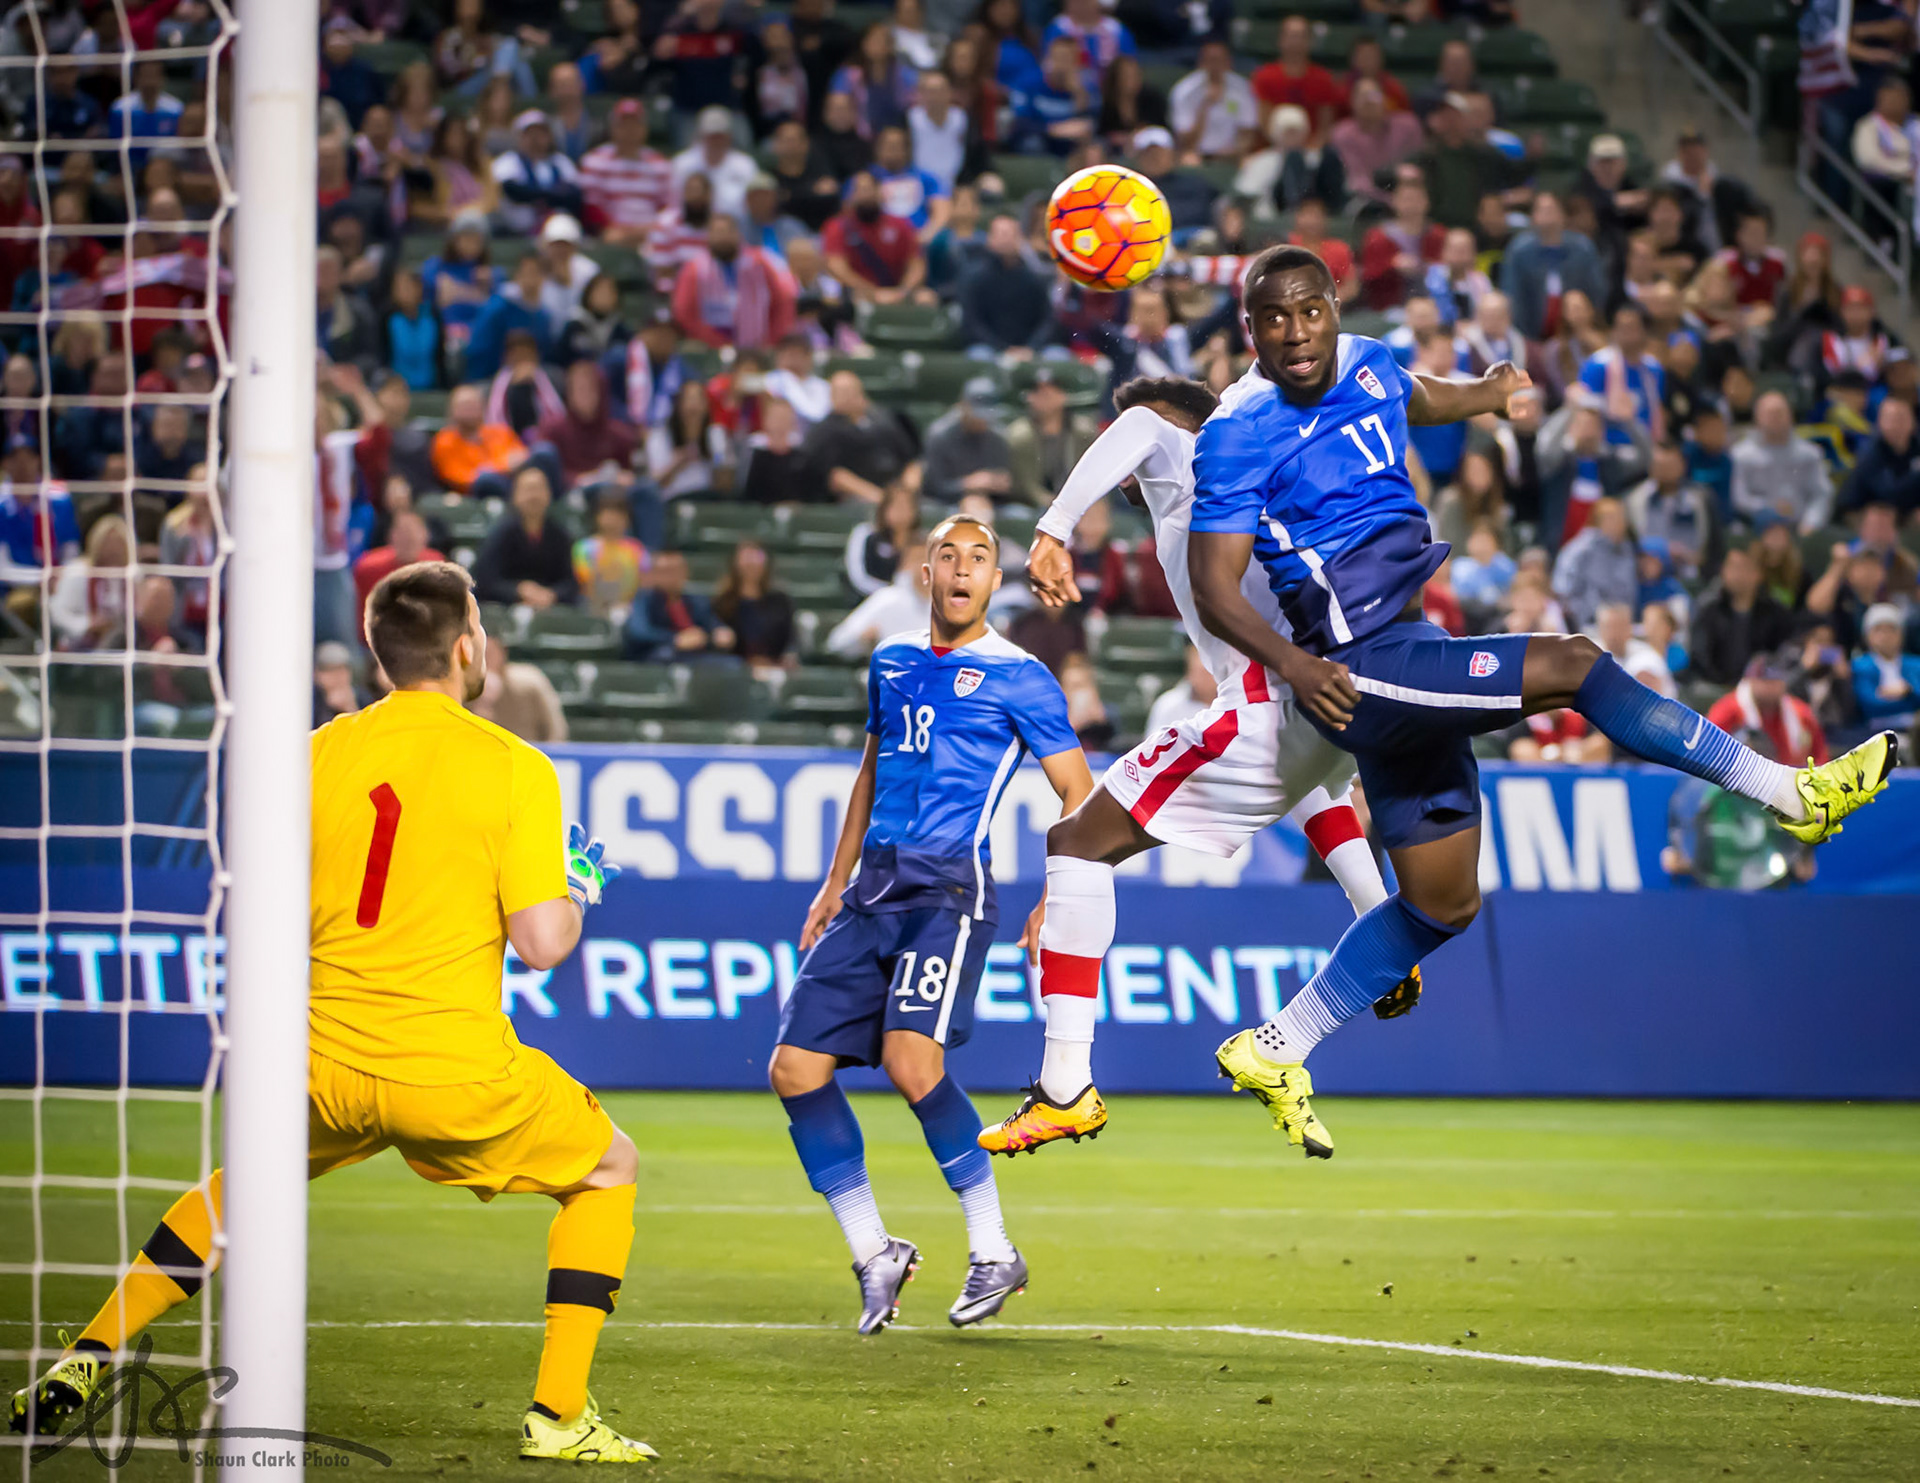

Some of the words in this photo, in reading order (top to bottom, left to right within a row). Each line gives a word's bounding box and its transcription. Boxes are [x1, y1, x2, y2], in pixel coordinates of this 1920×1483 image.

[1340, 413, 1395, 475] 17
[897, 704, 936, 754] 18
[356, 782, 402, 929] 1
[0, 931, 227, 1013] ETTE
[894, 951, 948, 1002] 18
